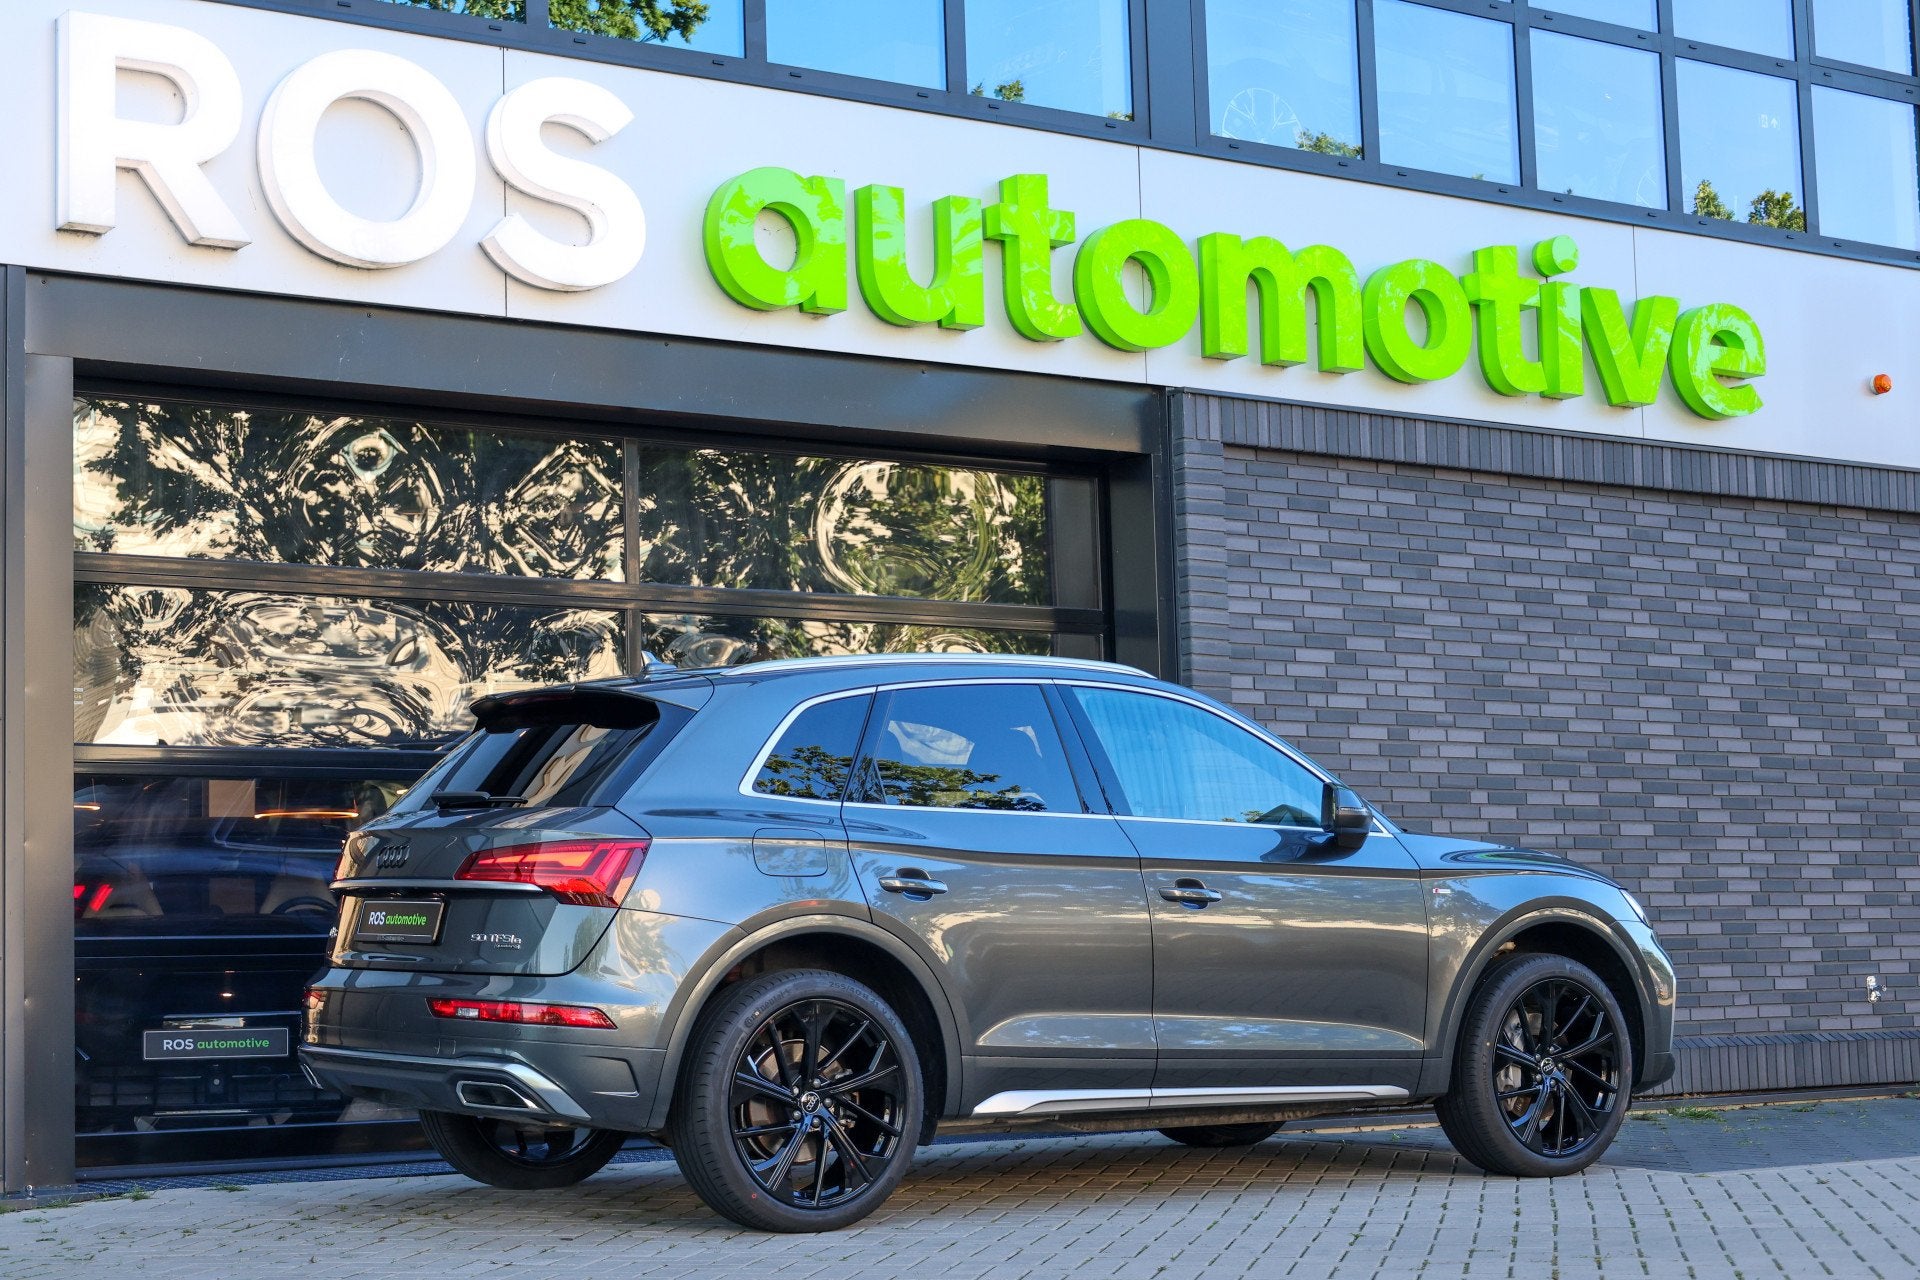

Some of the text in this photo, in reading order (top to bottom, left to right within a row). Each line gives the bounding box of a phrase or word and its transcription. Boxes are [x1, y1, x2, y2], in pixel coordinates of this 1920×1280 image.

[56, 9, 1767, 420] ROS automotive
[368, 911, 427, 926] ROS automotive
[163, 1037, 269, 1051] ROS automotive
